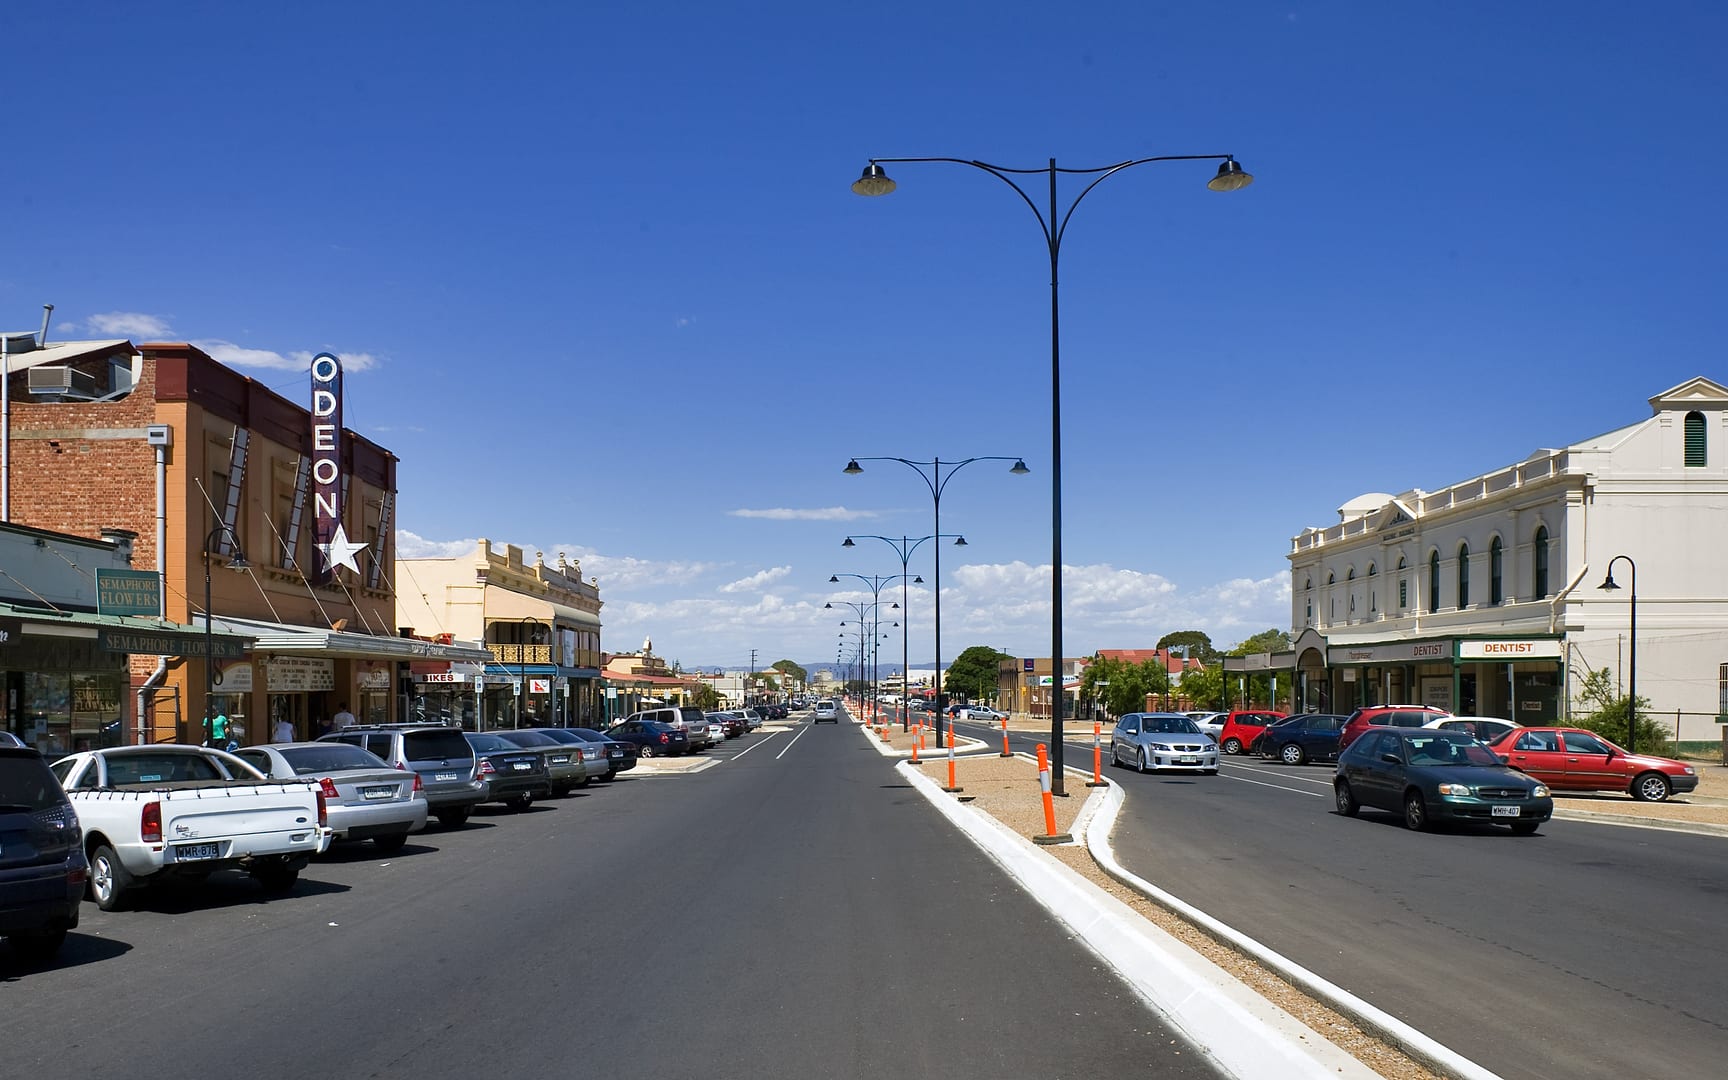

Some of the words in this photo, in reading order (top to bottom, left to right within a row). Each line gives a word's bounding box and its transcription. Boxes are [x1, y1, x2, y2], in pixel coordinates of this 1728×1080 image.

[312, 356, 338, 519] ODEON
[99, 579, 157, 592] SEMAPHORE
[101, 591, 158, 607] FLOWERS
[106, 634, 176, 653] SEMAPHORE
[1485, 643, 1533, 653] DENTIST
[1413, 644, 1443, 656] DENTIST
[422, 674, 454, 682] BIKES
[74, 701, 115, 711] FLOWERS
